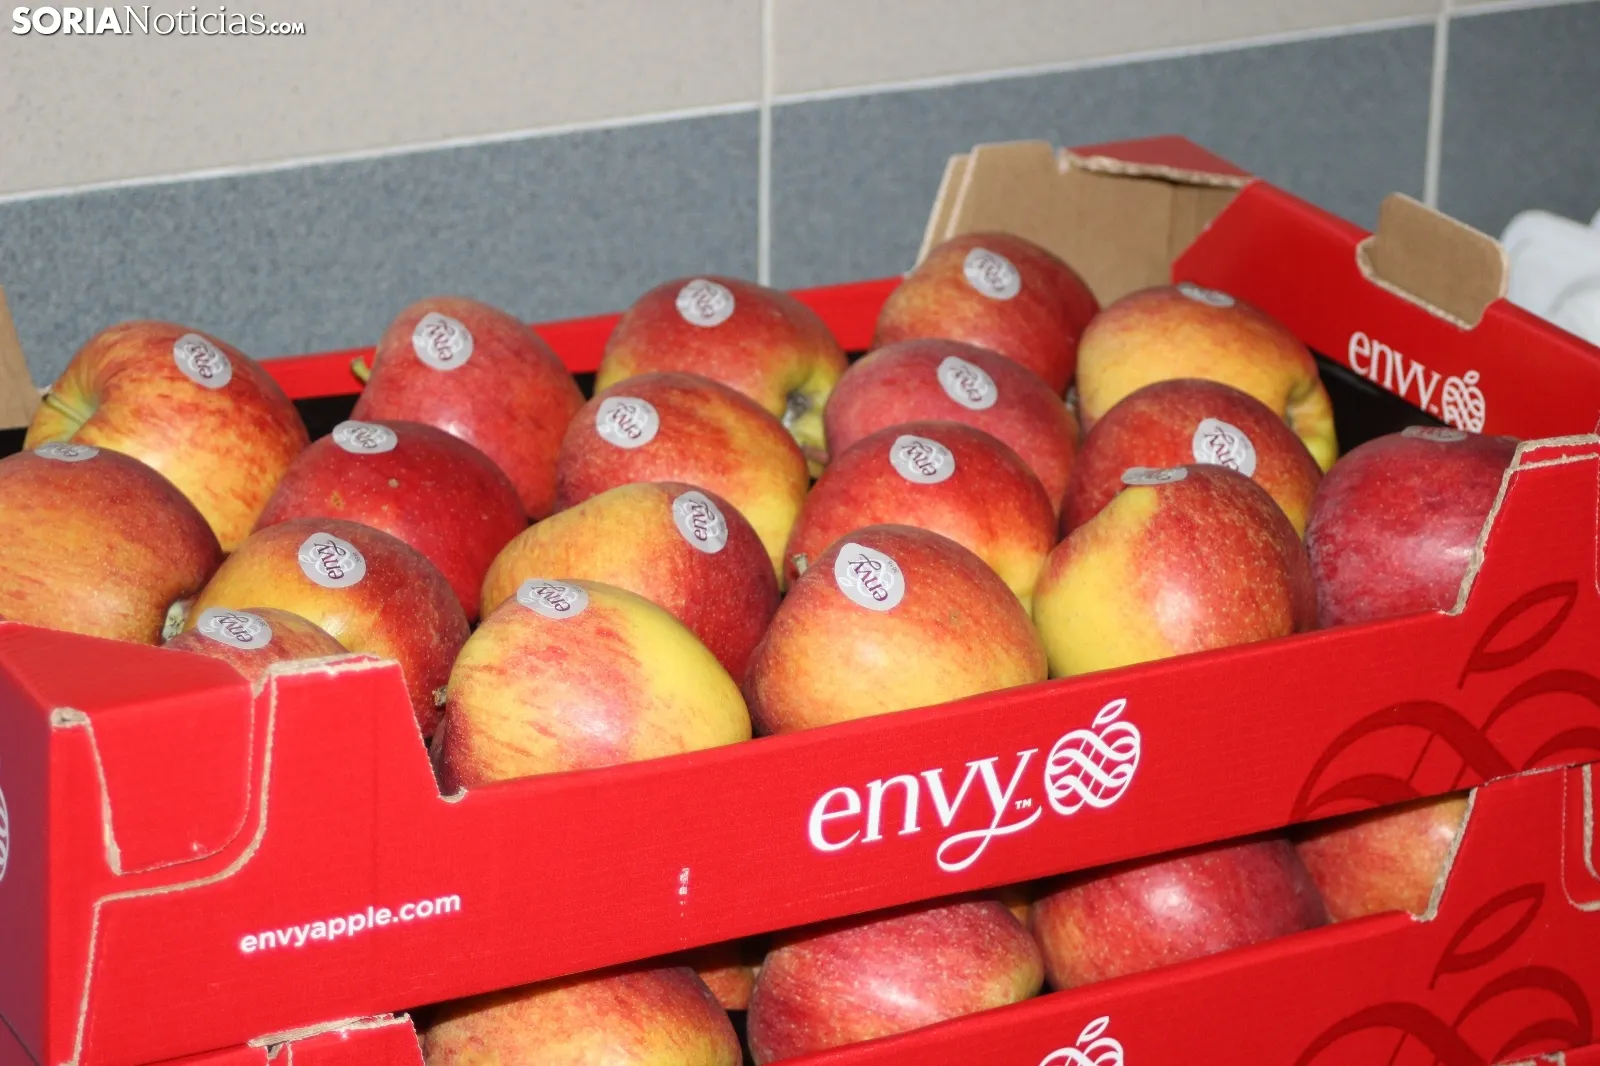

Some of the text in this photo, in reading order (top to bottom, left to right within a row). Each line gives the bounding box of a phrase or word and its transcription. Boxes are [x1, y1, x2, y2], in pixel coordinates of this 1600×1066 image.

[188, 341, 216, 378] envy
[424, 320, 455, 361] envy
[1348, 331, 1441, 412] envy
[605, 402, 641, 439] envy
[901, 441, 937, 475] envy
[688, 499, 715, 542] envy
[313, 540, 345, 580] envy
[847, 554, 889, 602] envy
[531, 583, 572, 612] envy
[213, 613, 253, 643] envy
[809, 748, 1042, 871] envy
[239, 894, 461, 953] envyapple.com
